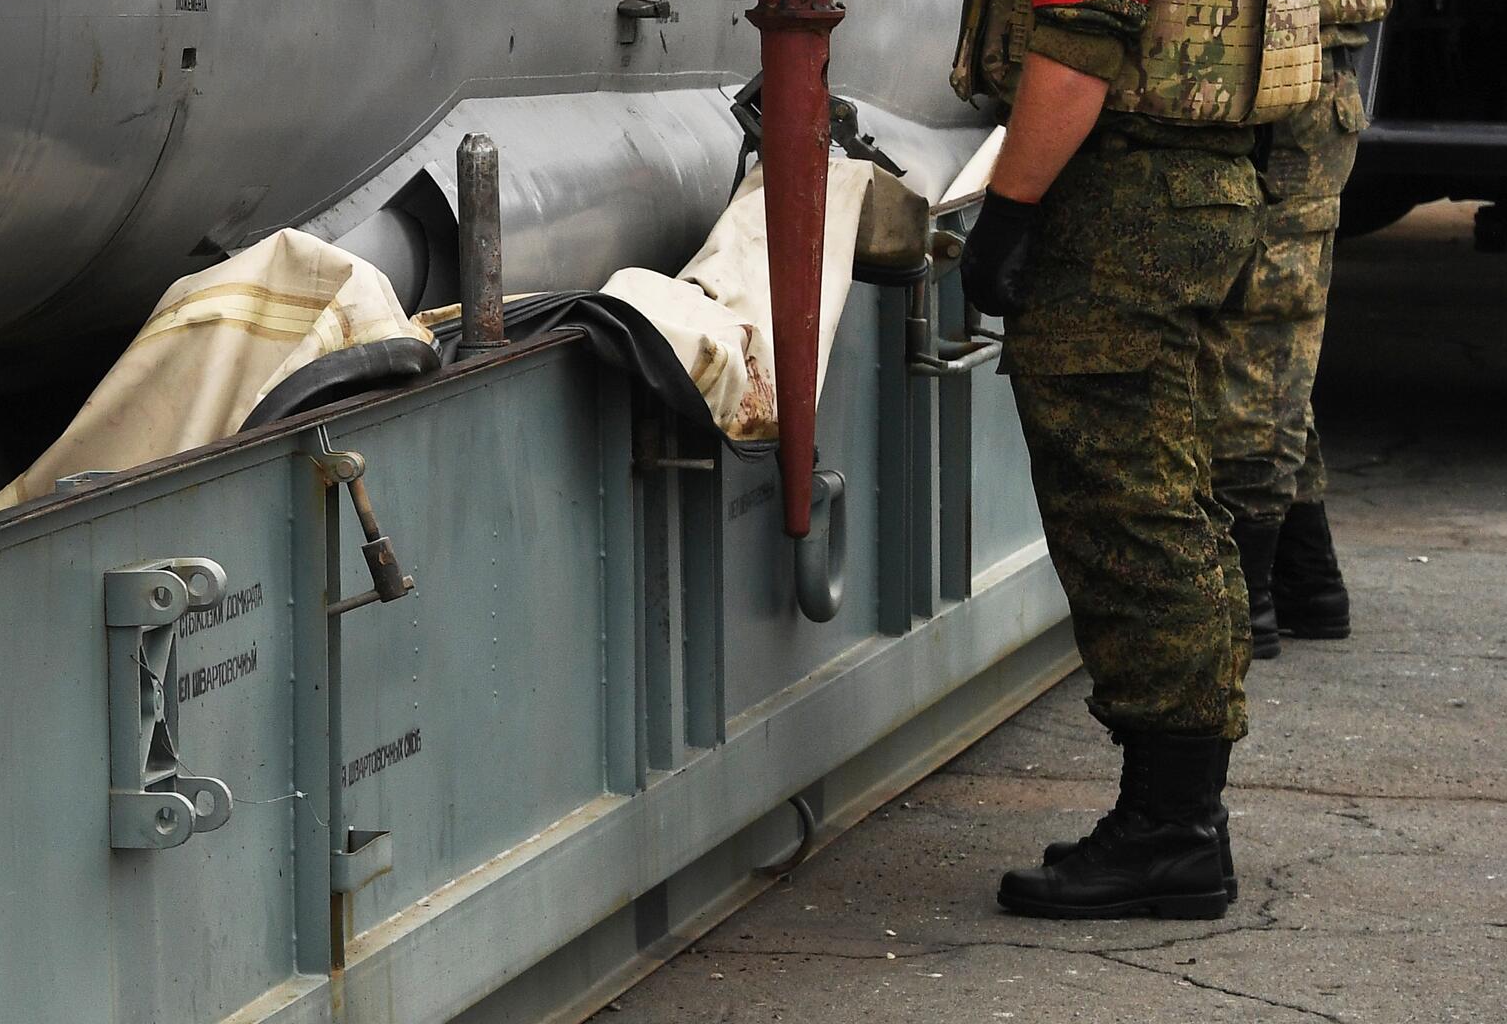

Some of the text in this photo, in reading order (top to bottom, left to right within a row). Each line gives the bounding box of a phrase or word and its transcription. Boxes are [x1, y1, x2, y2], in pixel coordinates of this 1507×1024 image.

[226, 582, 263, 622] ДОМКРАТА
[179, 640, 257, 703] ЕЛ ШВАРТОВОЧНЫЙ
